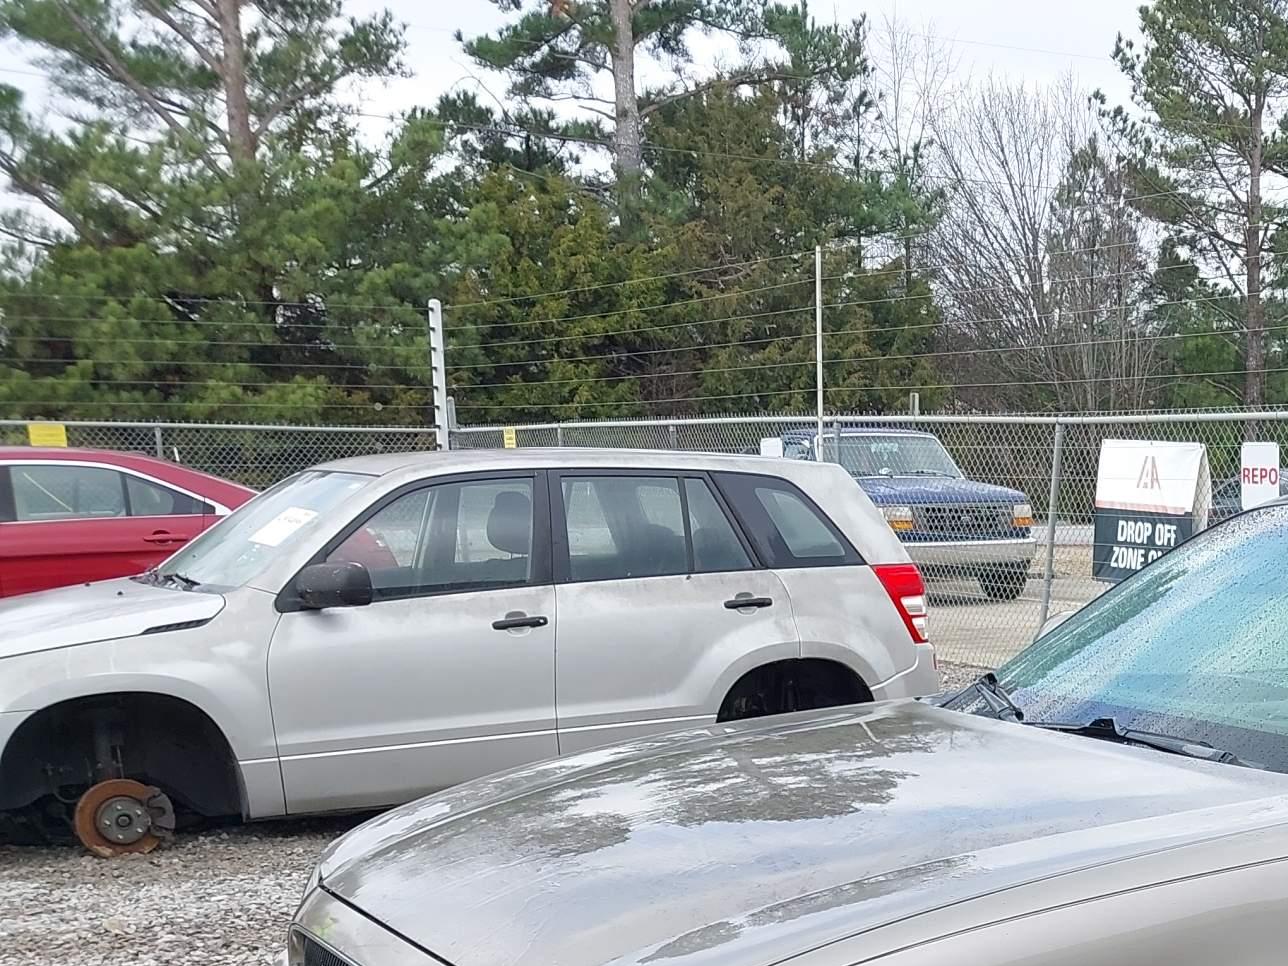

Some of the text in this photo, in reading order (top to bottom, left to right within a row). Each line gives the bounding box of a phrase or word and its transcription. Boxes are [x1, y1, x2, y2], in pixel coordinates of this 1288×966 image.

[1242, 467, 1279, 486] REPO
[1116, 519, 1177, 547] DROP OFF
[1110, 546, 1146, 570] ZONE
